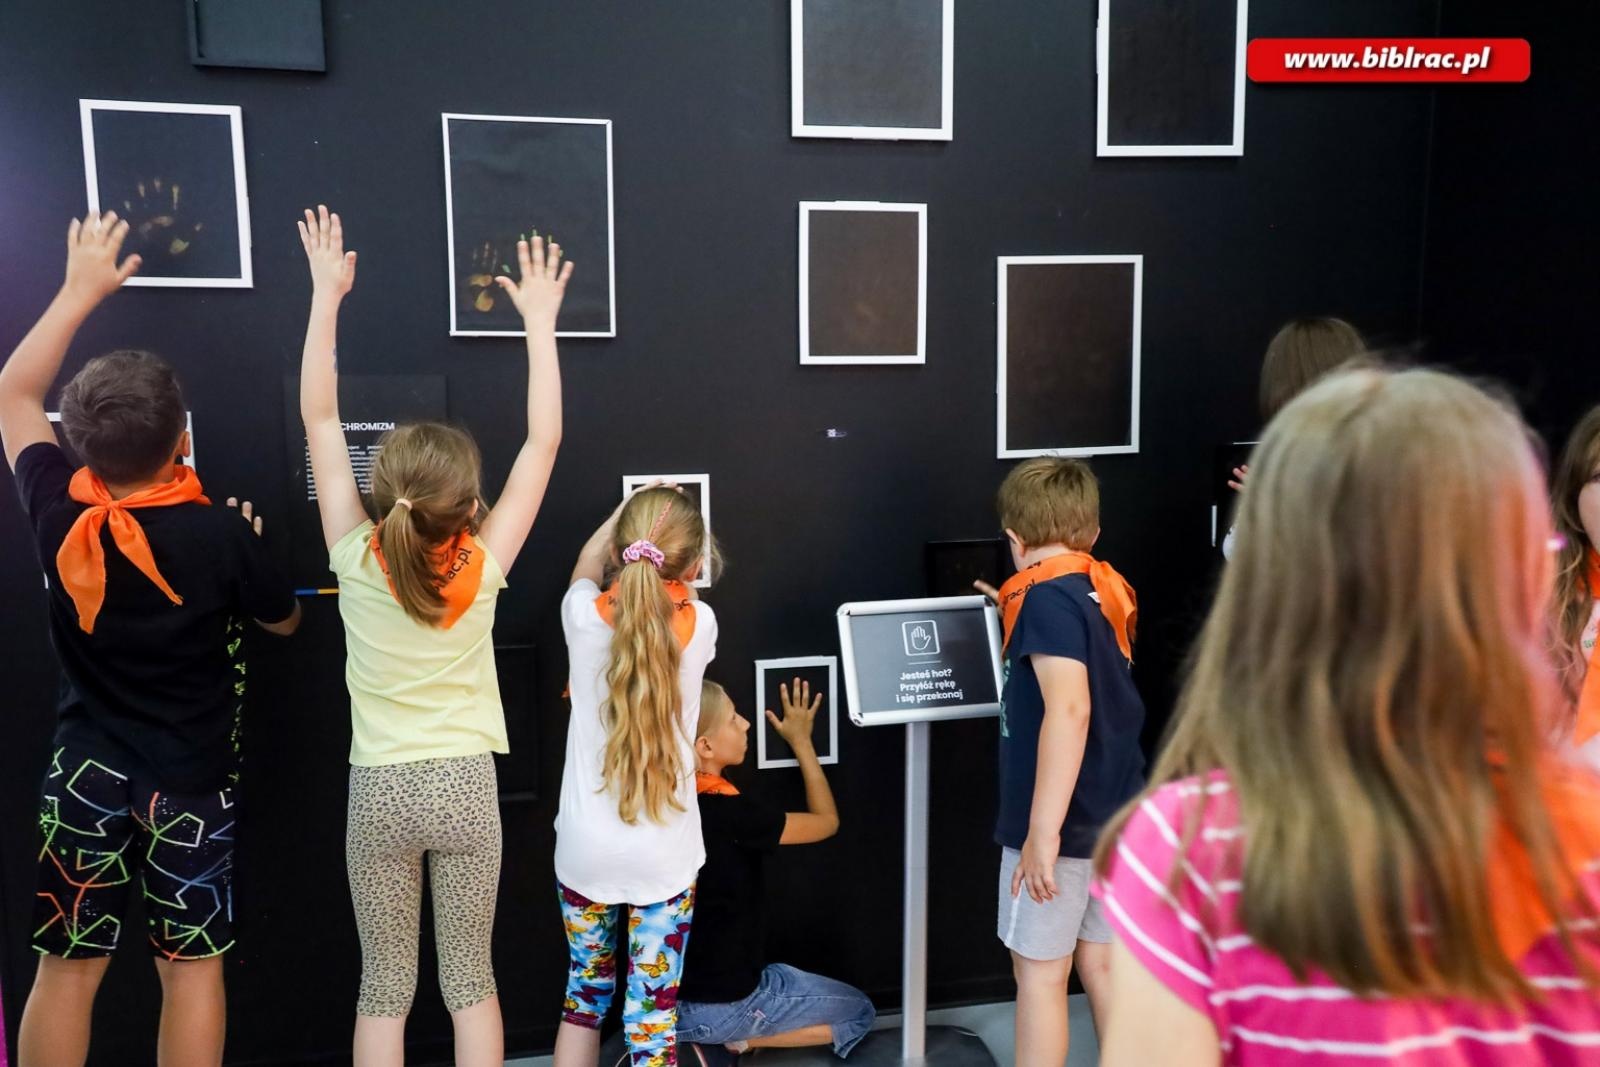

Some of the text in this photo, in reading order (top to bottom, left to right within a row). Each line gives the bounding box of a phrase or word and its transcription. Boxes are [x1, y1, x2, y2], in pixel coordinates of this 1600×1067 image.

[900, 668, 953, 681] Jesteś hot?
[900, 680, 956, 693] Przyłóż rękę
[896, 689, 963, 704] i się przekonaj
